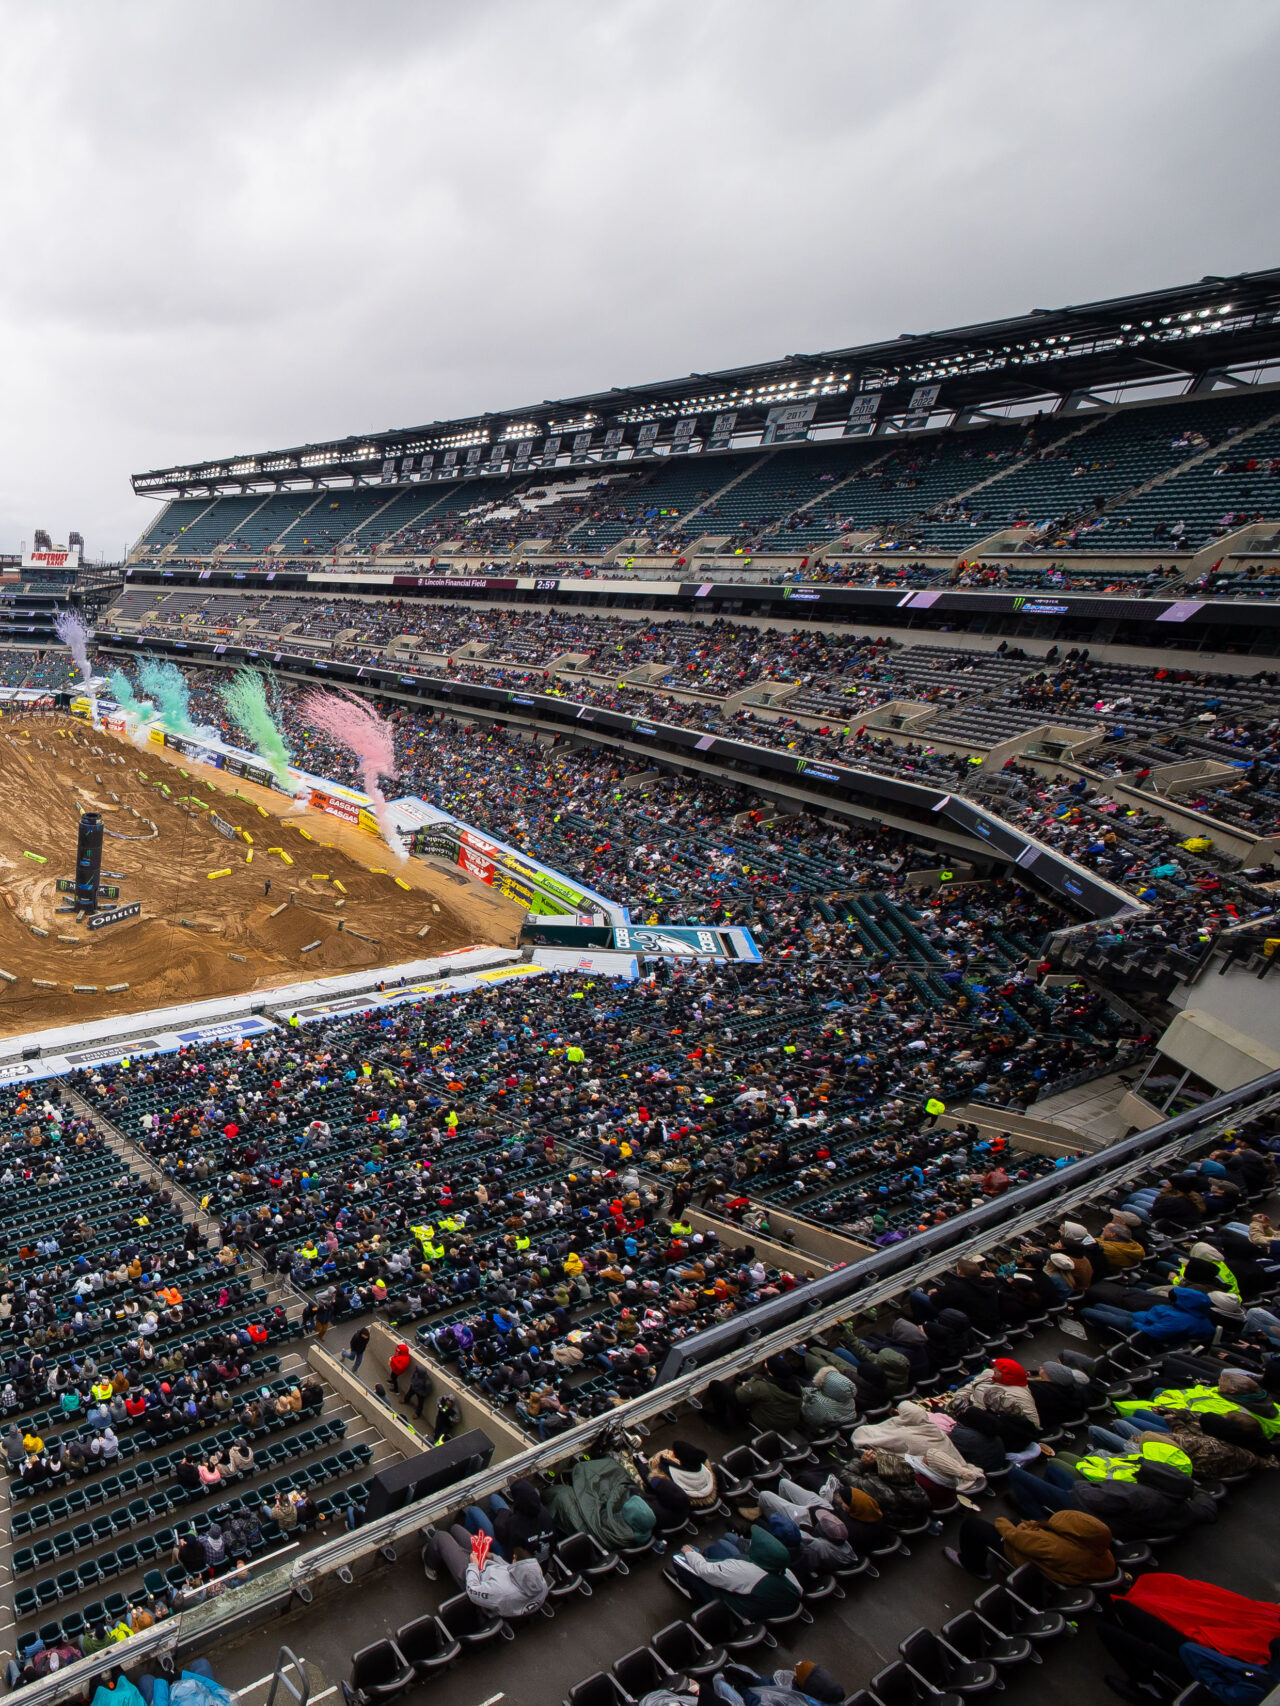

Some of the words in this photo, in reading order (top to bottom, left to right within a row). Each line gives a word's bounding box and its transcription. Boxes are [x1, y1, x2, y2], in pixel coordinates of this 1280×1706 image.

[912, 397, 934, 407] 2022
[854, 405, 875, 414] 2019
[786, 411, 808, 420] 2017
[424, 578, 445, 587] Lincoln
[445, 579, 471, 587] Financial
[537, 580, 556, 589] 2:59
[329, 798, 360, 814] GASGAS
[325, 808, 359, 823] GASGAS
[426, 836, 455, 847] MONSTER
[424, 846, 453, 856] MONSTER
[541, 878, 575, 898] Kawasaki
[105, 906, 140, 922] OAKLEY
